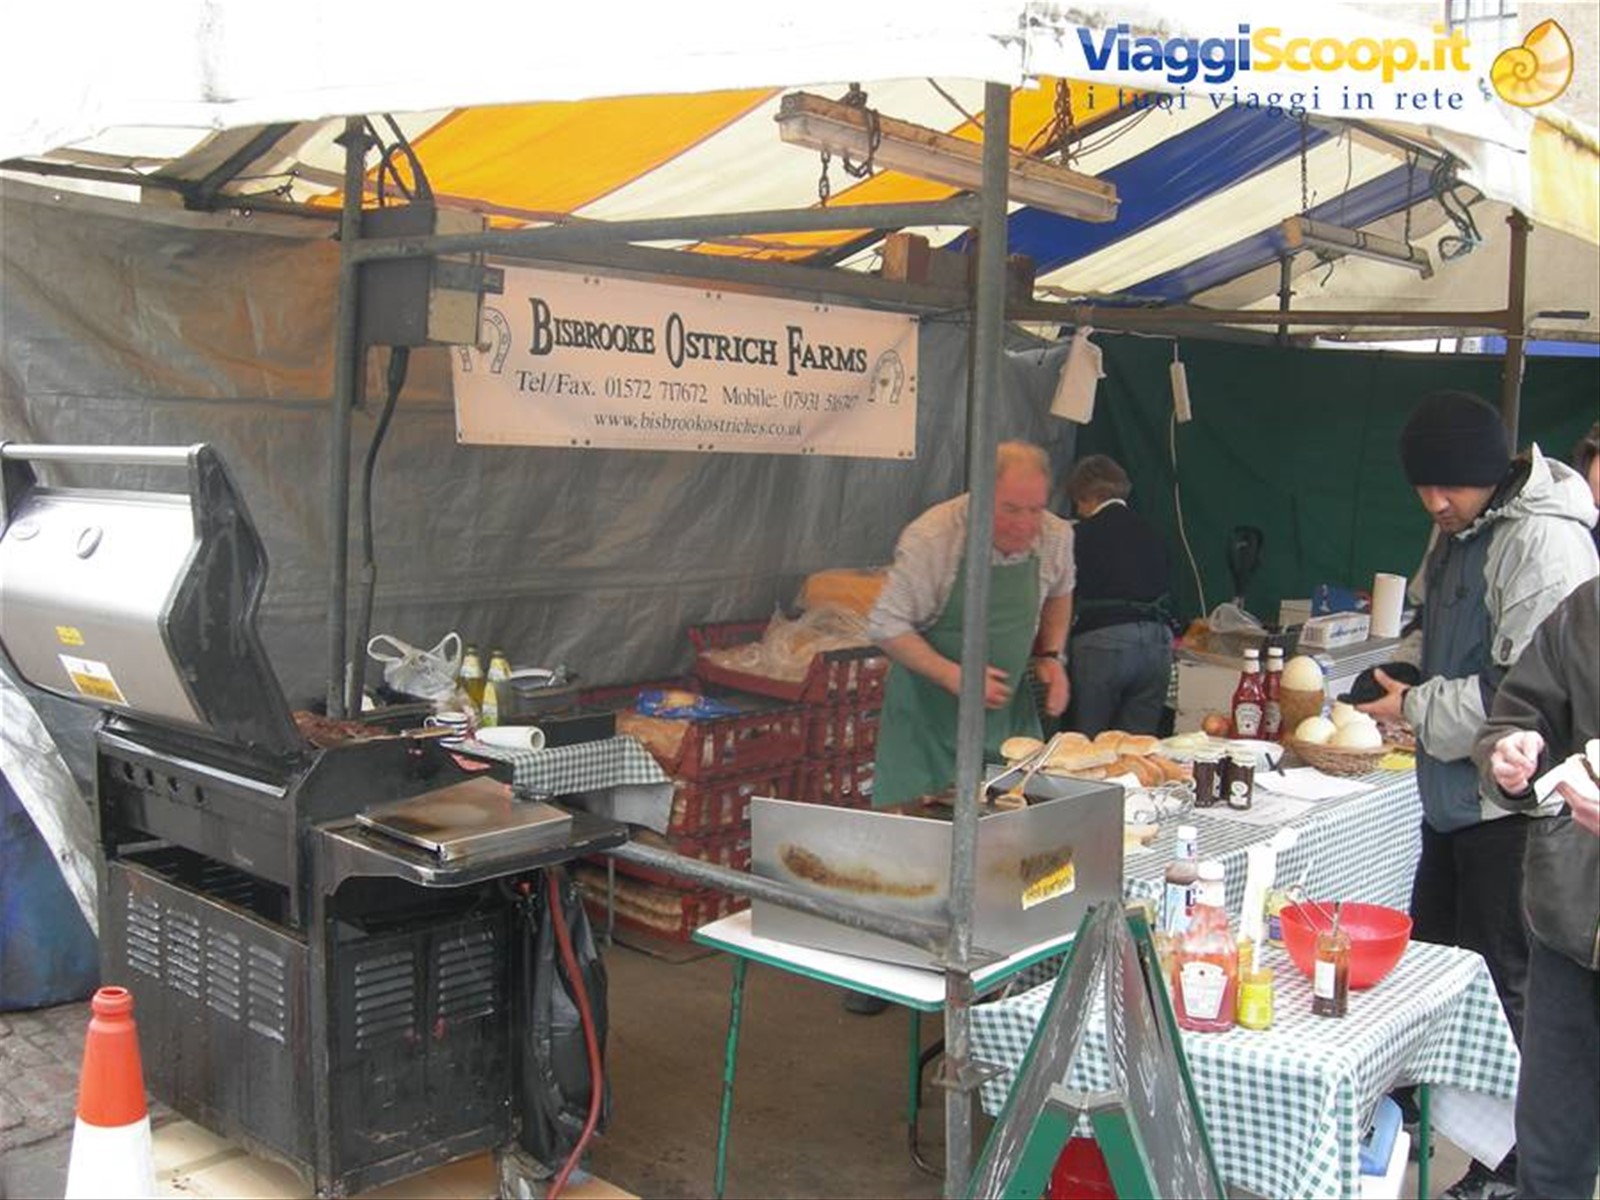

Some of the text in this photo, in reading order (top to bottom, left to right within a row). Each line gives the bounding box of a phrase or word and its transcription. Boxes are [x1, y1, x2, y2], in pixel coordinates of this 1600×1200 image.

[528, 297, 656, 355] BISBROOKE
[665, 312, 778, 369] OSTRICH
[786, 325, 867, 376] FARMS
[515, 369, 596, 397] Tel/Fax.
[604, 376, 652, 399] 01572
[722, 385, 778, 409] Mobile:
